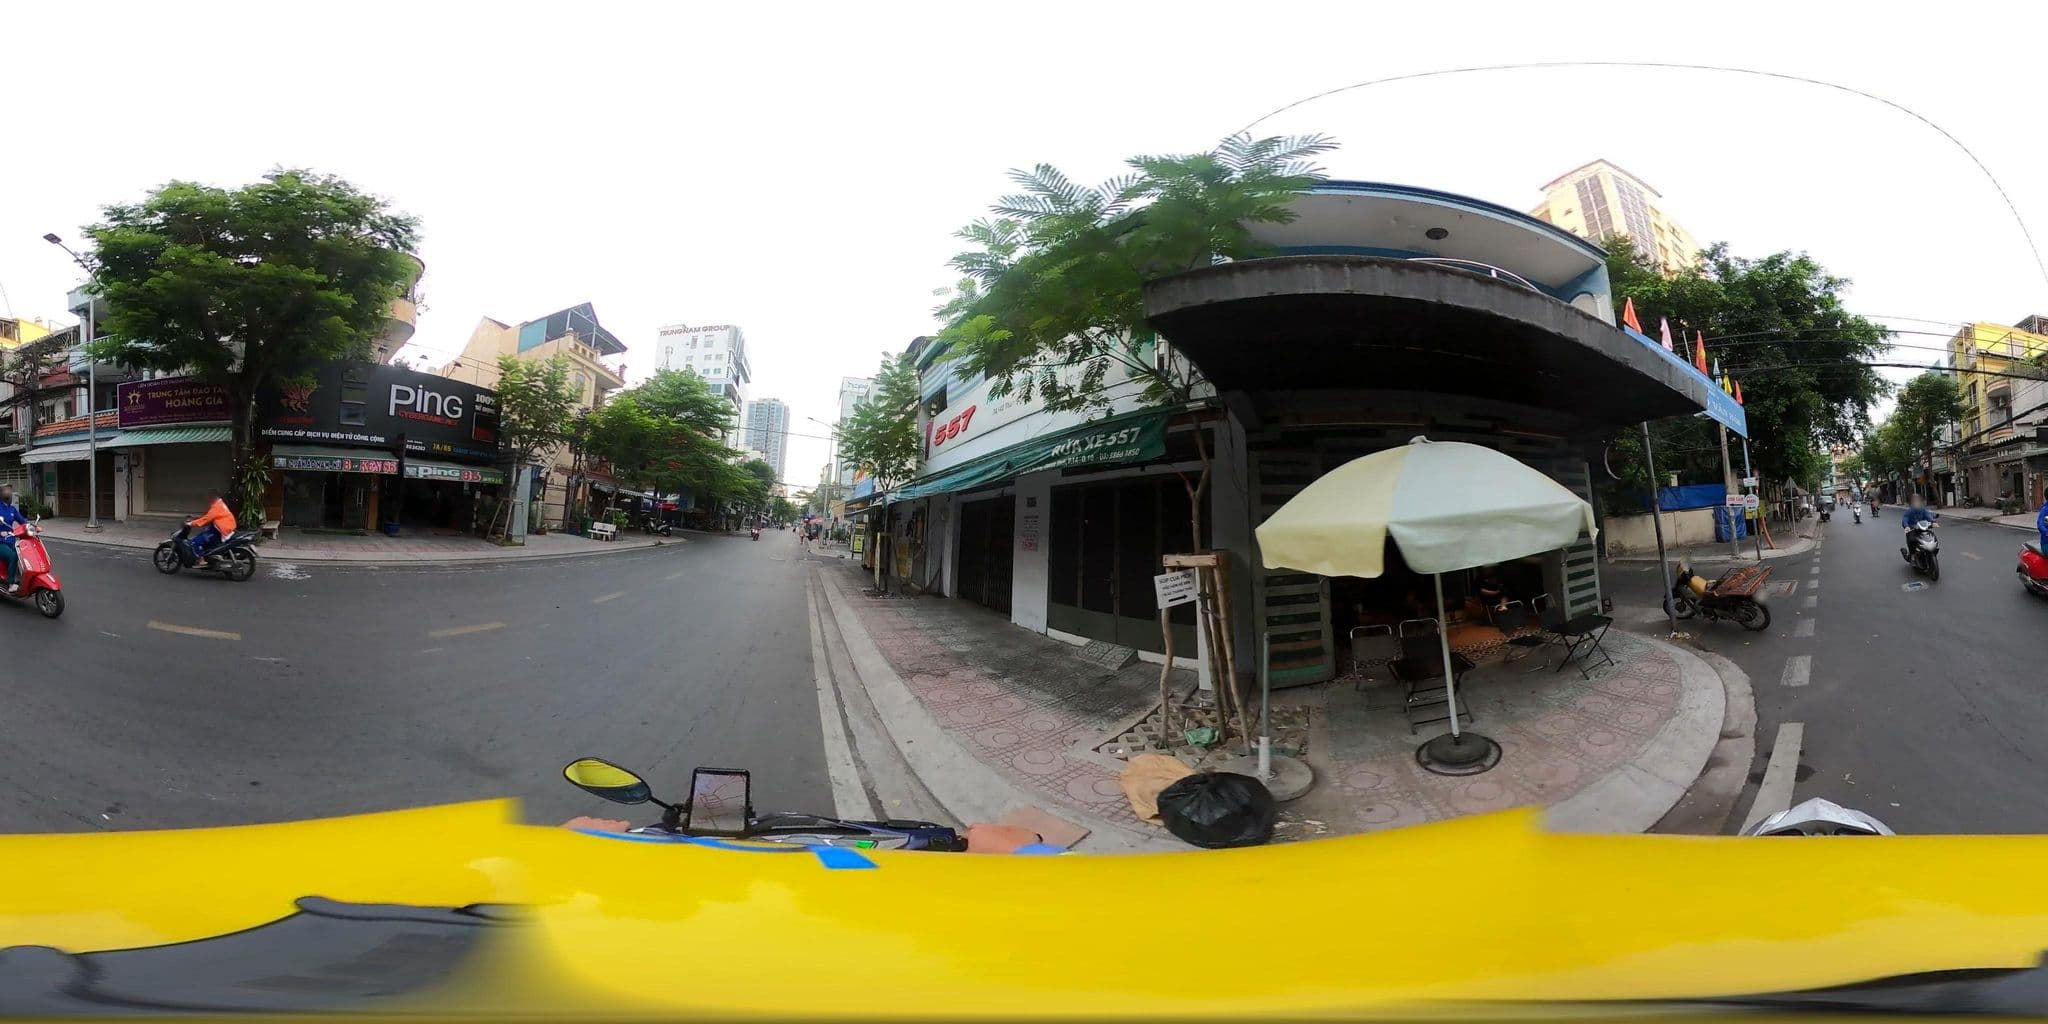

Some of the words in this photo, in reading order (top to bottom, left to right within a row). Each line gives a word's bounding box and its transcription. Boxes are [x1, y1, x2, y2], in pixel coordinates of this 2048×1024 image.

[147, 389, 175, 400] TRUNG
[165, 395, 203, 409] HOÀNG
[934, 404, 977, 447] 557
[1051, 438, 1082, 457] RỬA
[1084, 433, 1105, 451] XE
[1106, 426, 1142, 446] 557
